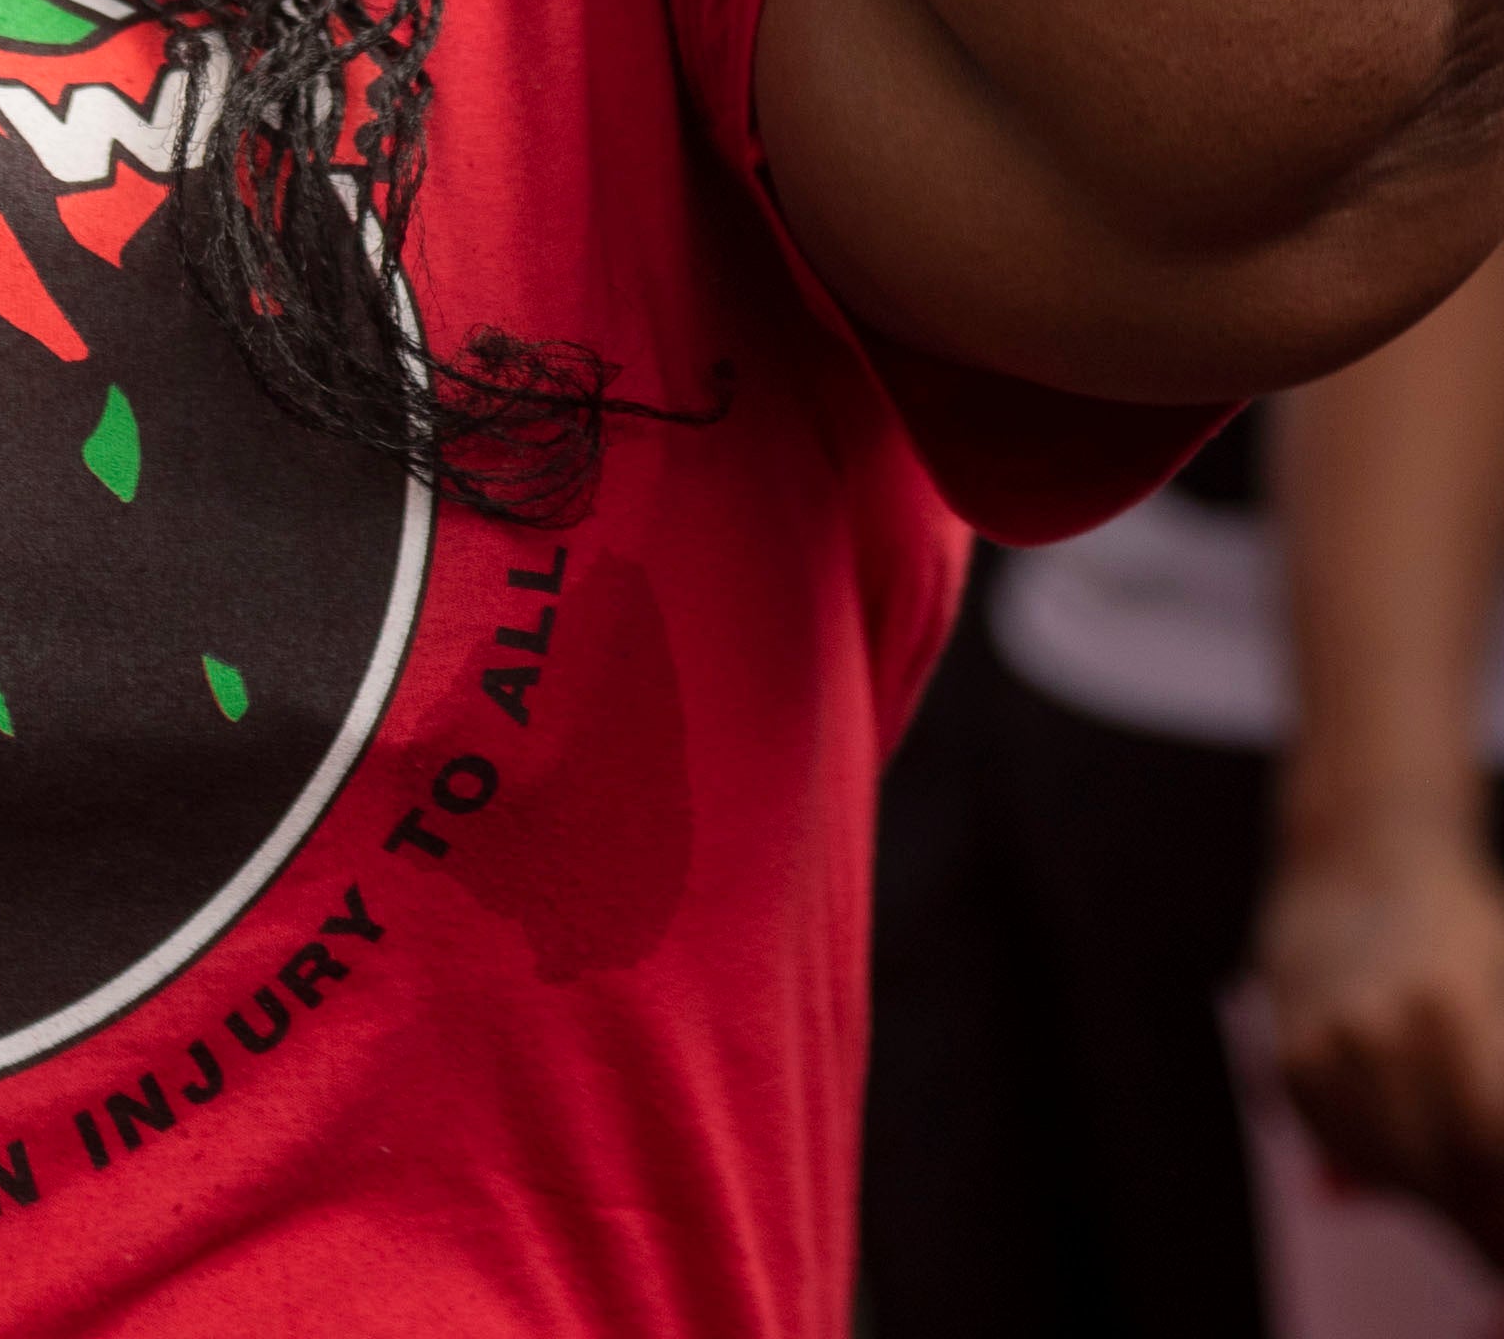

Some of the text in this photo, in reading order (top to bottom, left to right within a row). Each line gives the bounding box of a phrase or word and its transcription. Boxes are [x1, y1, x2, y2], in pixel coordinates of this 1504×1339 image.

[73, 883, 385, 1169] INJURY
[382, 754, 499, 859] TO
[482, 546, 569, 727] ALL
